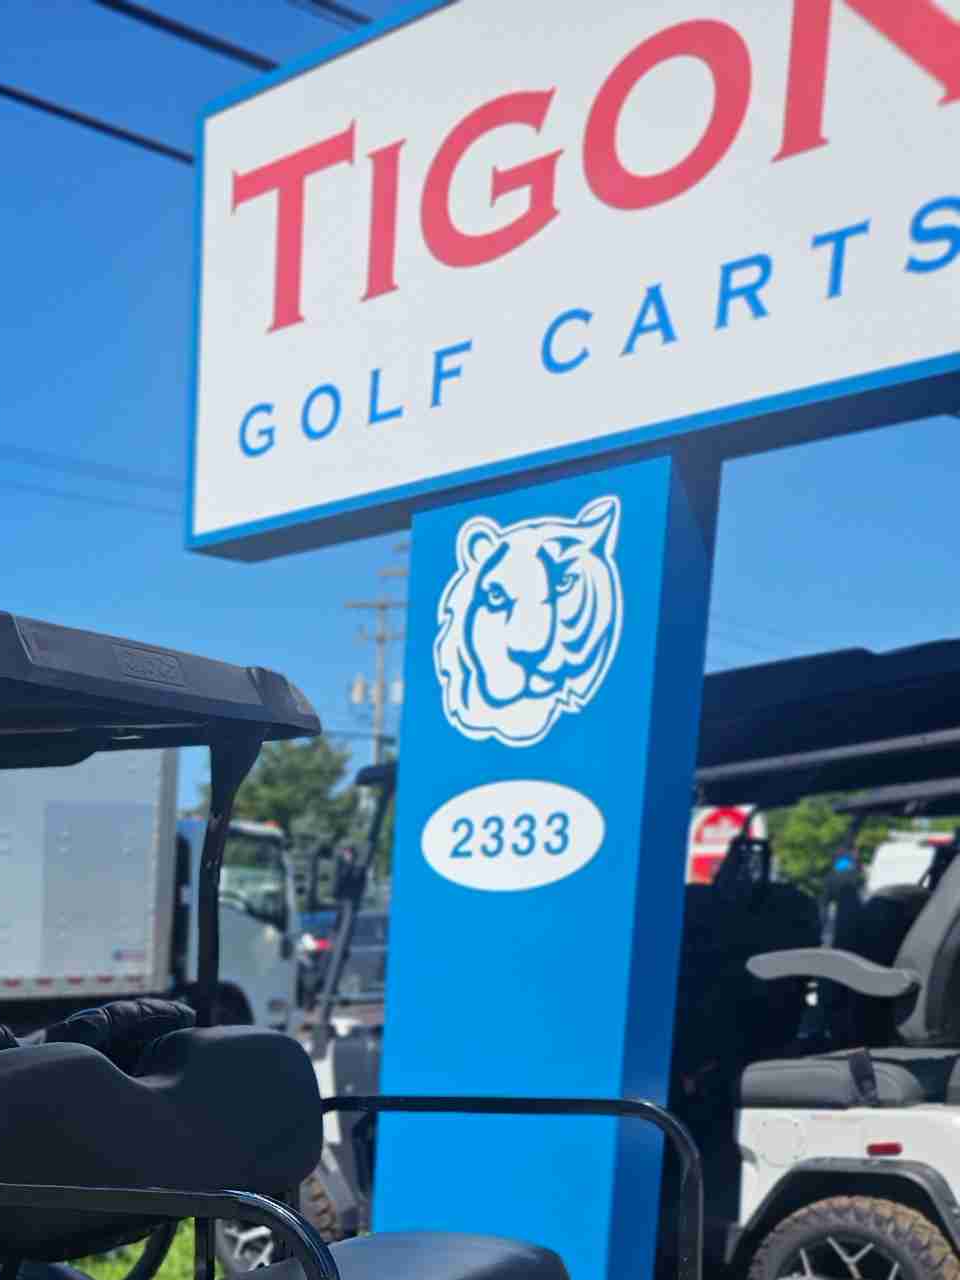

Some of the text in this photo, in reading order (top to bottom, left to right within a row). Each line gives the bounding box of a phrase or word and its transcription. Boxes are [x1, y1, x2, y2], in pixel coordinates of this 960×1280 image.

[238, 194, 960, 460] GOLF CARTS
[449, 811, 570, 859] 2333
